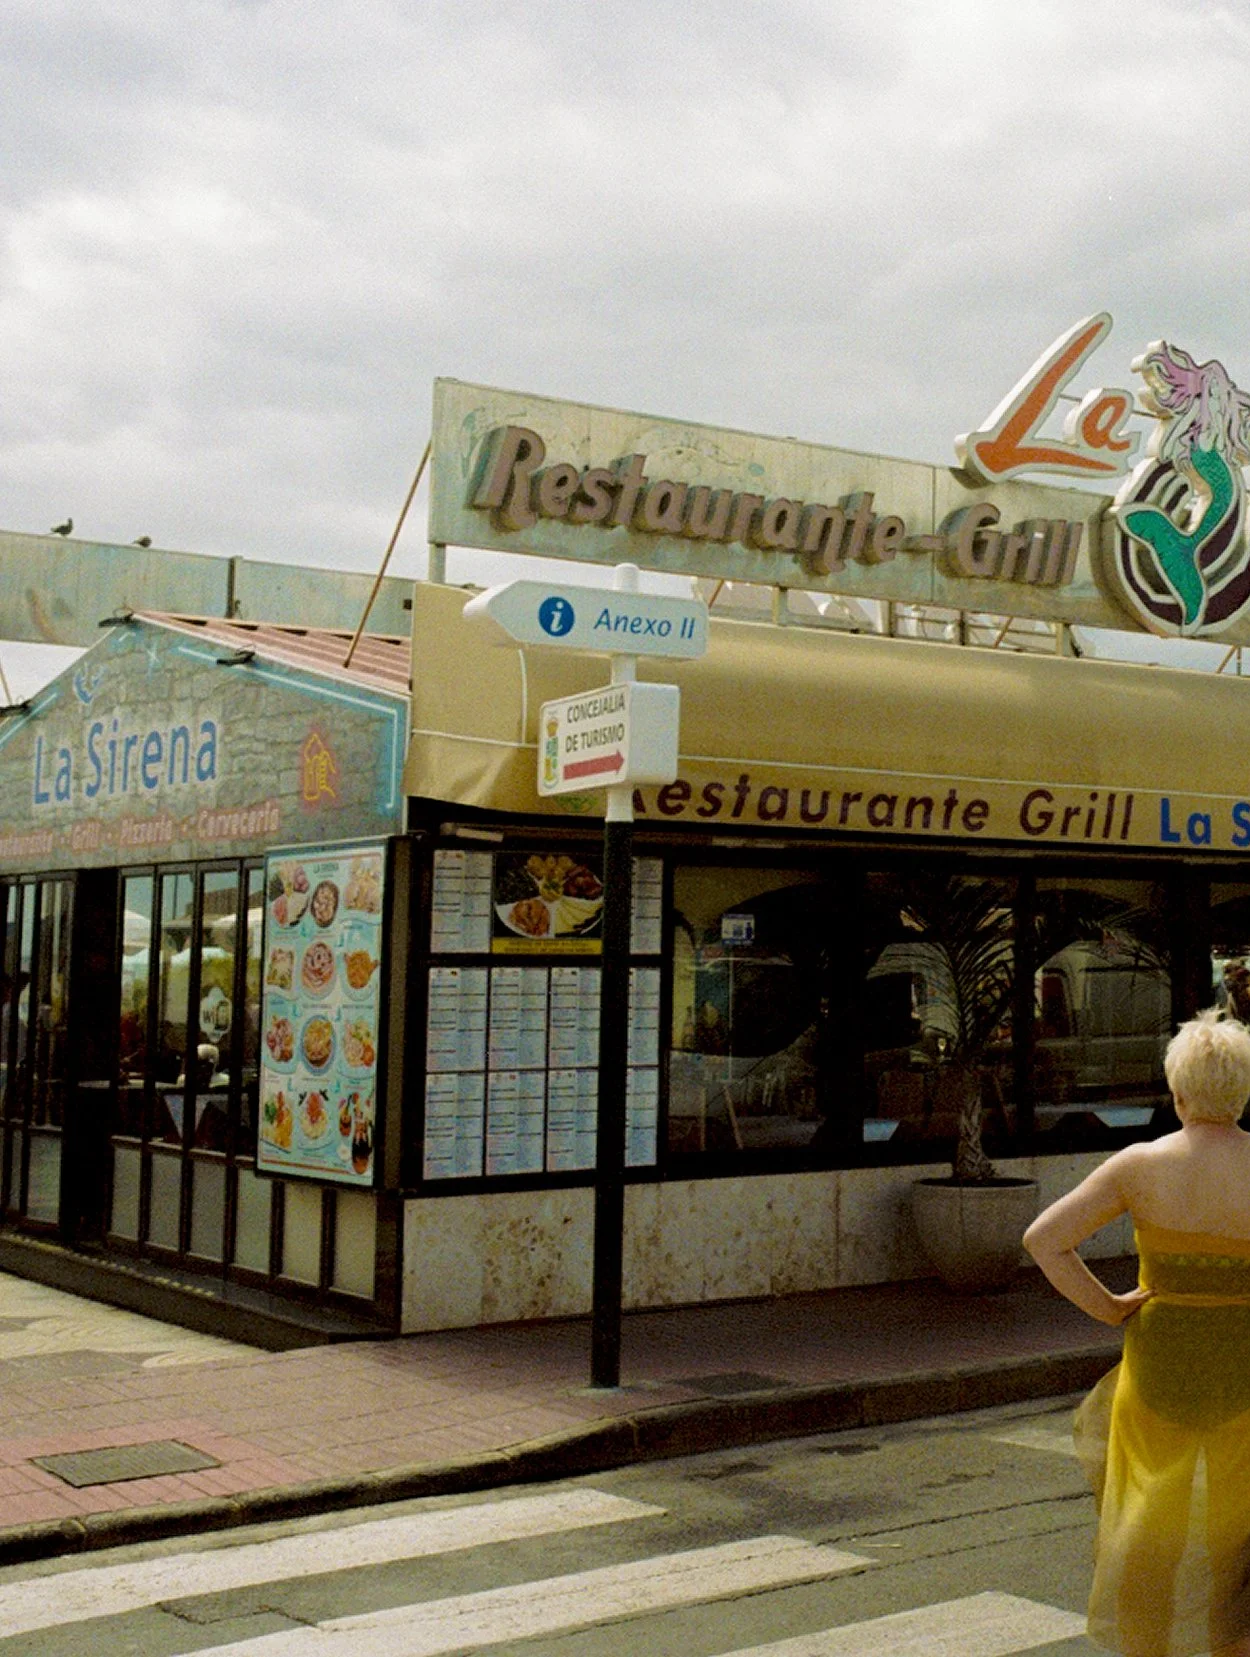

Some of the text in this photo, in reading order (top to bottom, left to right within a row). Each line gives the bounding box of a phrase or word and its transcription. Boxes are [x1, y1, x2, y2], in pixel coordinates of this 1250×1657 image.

[954, 312, 1140, 487] La
[594, 608, 672, 638] Anexo
[680, 616, 696, 640] II
[33, 717, 217, 804] La Sirena
[565, 722, 625, 754] DE TURISMO
[198, 798, 281, 838] Cerveceria
[1019, 789, 1135, 841] Grill
[1160, 797, 1210, 845] La
